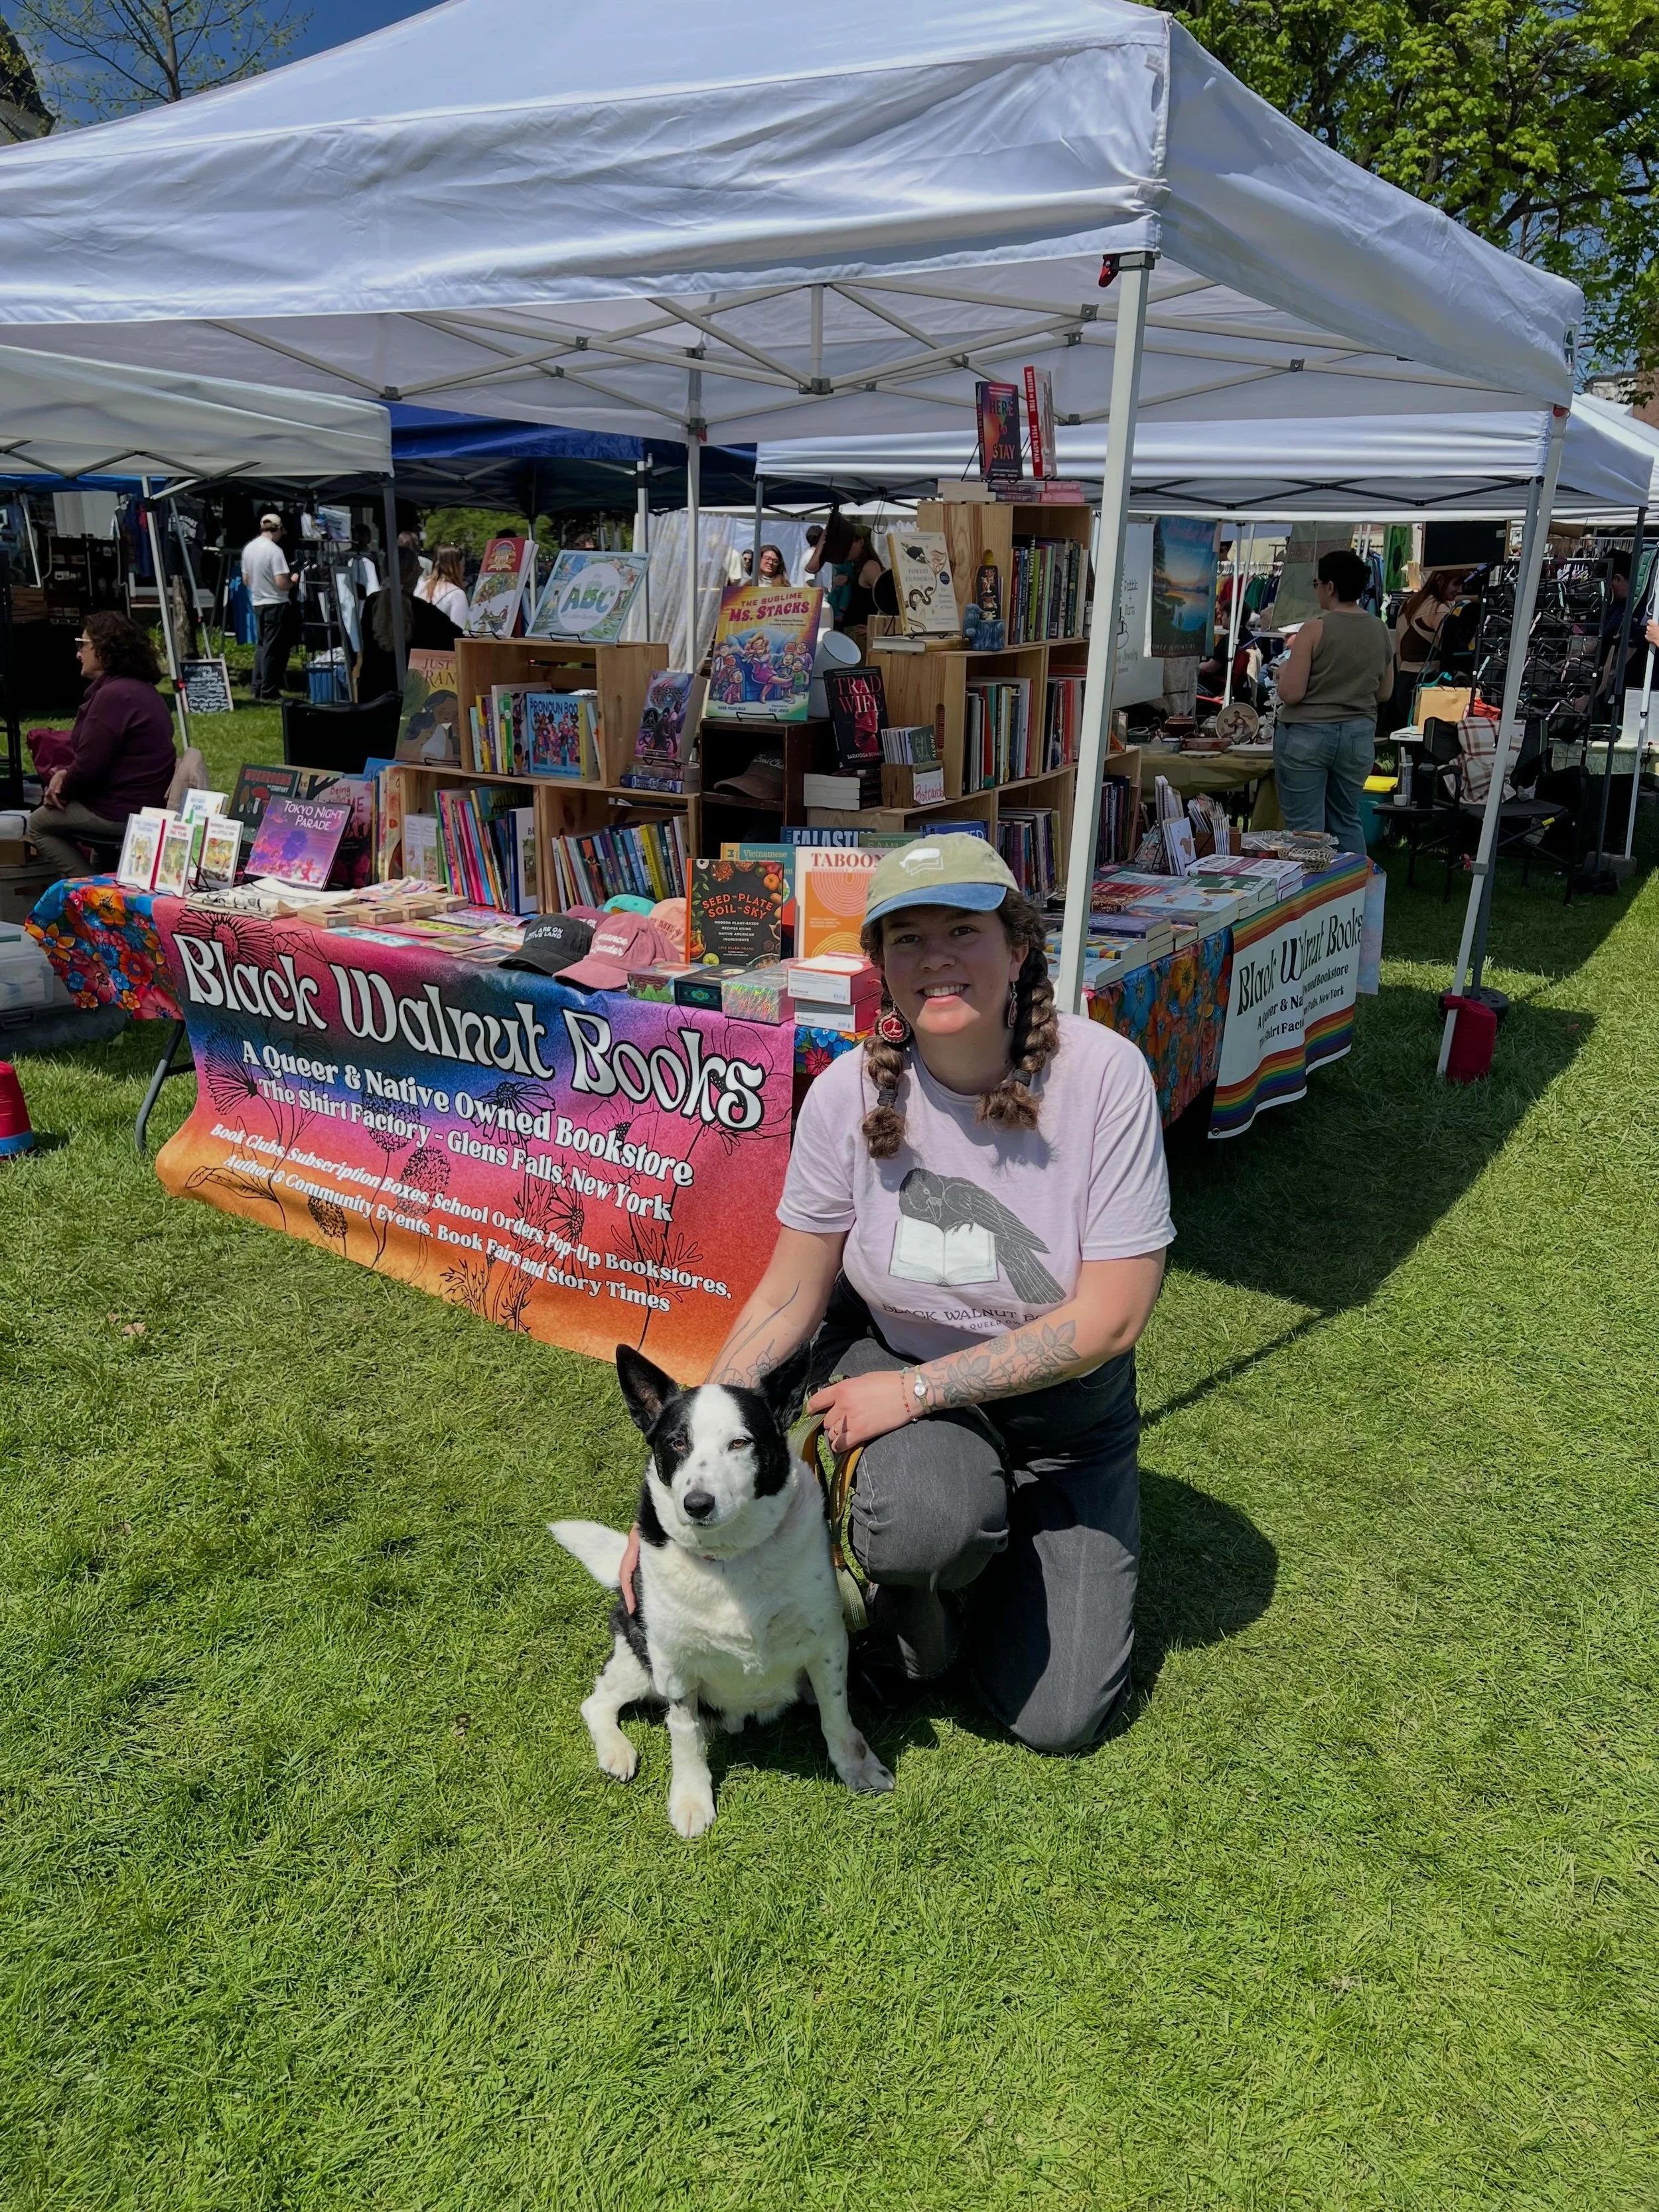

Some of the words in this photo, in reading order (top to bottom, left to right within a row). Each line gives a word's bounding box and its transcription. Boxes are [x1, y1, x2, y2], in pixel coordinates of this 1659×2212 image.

[990, 400, 1013, 416] HERE
[993, 443, 1015, 459] STAY
[561, 581, 616, 613] ABC
[761, 592, 803, 604] SUBLIME
[729, 609, 753, 621] MS.
[422, 658, 452, 670] JUST
[413, 670, 457, 688] GRAN
[833, 675, 882, 696] TRAD
[530, 701, 563, 714] PRONOUN
[564, 702, 578, 714] BOO
[839, 695, 883, 713] WIFE
[330, 786, 350, 795] Being
[284, 800, 314, 816] TOKYO
[295, 815, 332, 830] PARADE
[743, 849, 788, 858] Vietnamese
[812, 853, 885, 867] TABOON
[702, 893, 730, 909] SEED
[739, 893, 773, 911] PLATE
[708, 904, 736, 918] SOIL
[743, 905, 767, 920] SKY
[1237, 948, 1277, 1016] Black
[1326, 907, 1363, 957] Books
[1280, 999, 1287, 1011] &
[1317, 964, 1348, 986] Bookstore
[1281, 1019, 1305, 1034] Facto
[1330, 986, 1344, 1000] York
[173, 933, 328, 1030] Black
[331, 963, 555, 1080] Walnut
[562, 1008, 765, 1131] Books
[243, 1041, 261, 1065] A
[263, 1045, 339, 1093] Queer
[344, 1065, 362, 1090] &
[364, 1069, 450, 1114] Native
[455, 1090, 551, 1142] Owned
[557, 1116, 694, 1187] Bookstore
[259, 1078, 295, 1106] The
[299, 1086, 348, 1121] Shirt
[350, 1104, 431, 1149] Factory
[447, 1131, 509, 1167] Glens
[510, 1148, 567, 1188] Falls,
[570, 1166, 616, 1201] New
[614, 1184, 673, 1223] York
[210, 1124, 246, 1145] Book
[245, 1133, 285, 1159] Clubs,
[286, 1147, 378, 1189] Subscription
[380, 1176, 431, 1207] Boxes,
[431, 1192, 488, 1224] School
[492, 1209, 545, 1246] Orders,
[545, 1234, 601, 1270] Pop-Up
[605, 1252, 732, 1299] Bookstores,
[223, 1154, 273, 1183] Author
[273, 1169, 283, 1183] &
[285, 1174, 375, 1219] Community
[375, 1204, 435, 1238] Events,
[436, 1223, 484, 1252] Book
[486, 1237, 520, 1266] Fairs
[519, 1253, 545, 1280] and
[545, 1265, 603, 1297] Story
[605, 1280, 671, 1313] Times
[944, 1308, 1017, 1321] WALNUT
[970, 1320, 1002, 1330] QUEER
